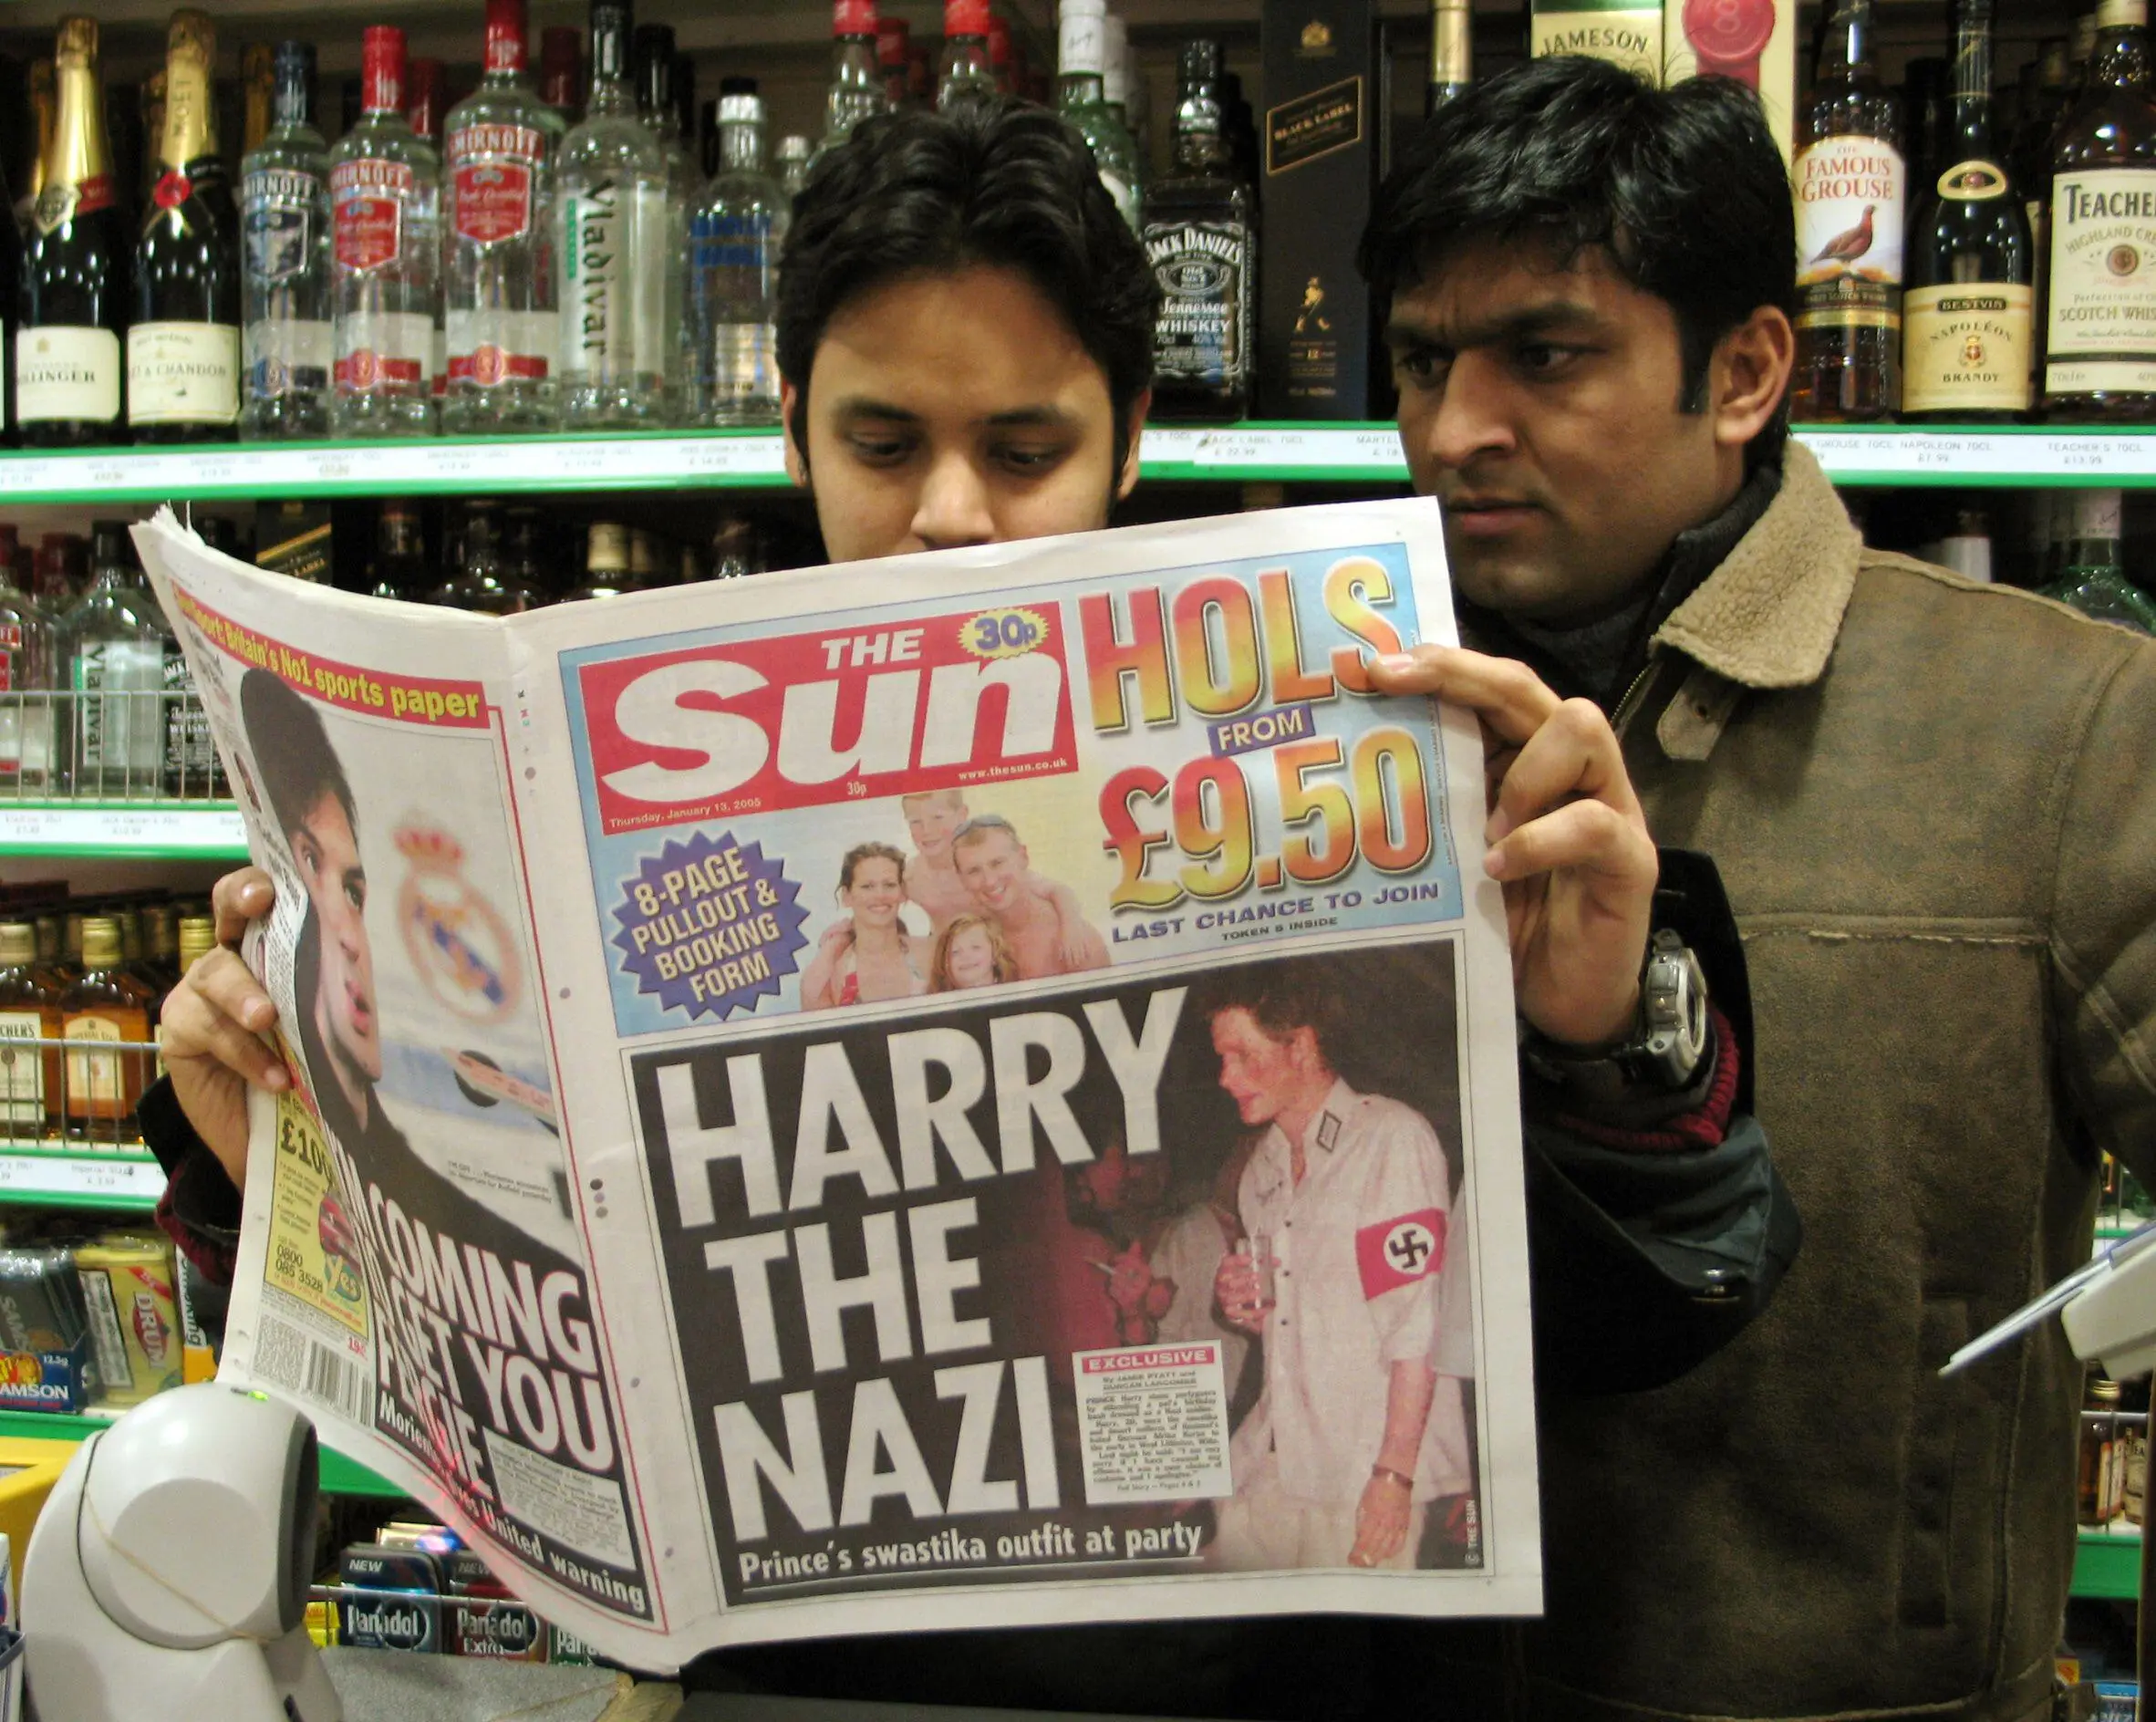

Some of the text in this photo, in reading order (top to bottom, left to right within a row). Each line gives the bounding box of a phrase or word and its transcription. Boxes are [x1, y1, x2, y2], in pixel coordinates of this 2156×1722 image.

[1540, 27, 1649, 56] JAMESON
[1804, 156, 1892, 180] FAMOUS
[1802, 180, 1893, 202] GROUSE
[2063, 183, 2156, 224] TEACHE
[1145, 234, 1184, 265] JACK
[2065, 225, 2133, 255] HIGHLAND
[583, 179, 616, 356] Vladivar
[1156, 319, 1231, 333] WHISKEY
[2059, 306, 2118, 322] SCOTCH
[1942, 371, 2000, 383] BRANDY
[1900, 441, 1961, 451] NAPOLEON
[821, 628, 928, 671] THE
[974, 614, 1038, 651] 30p
[1078, 555, 1405, 734] HOLS
[280, 649, 313, 688] No1
[314, 668, 385, 707] sports
[390, 685, 480, 721] paper
[600, 652, 1062, 804] Sun
[1218, 708, 1305, 752] FROM
[846, 781, 868, 797] 30p
[958, 756, 1069, 783] www.thesun.co.uk
[609, 812, 664, 829] Thursday,
[666, 804, 711, 821] January
[1097, 727, 1432, 916] £9.50
[633, 845, 750, 918] 8-PAGE
[630, 877, 780, 955] PULLOUT &
[1112, 883, 1439, 944] LAST CHANCE TO JOIN
[1222, 927, 1270, 942] TOKEN
[1289, 916, 1339, 930] INSIDE
[654, 912, 781, 981] BOOKING
[689, 949, 772, 1003] FORM
[655, 986, 1189, 1229] HARRY
[368, 1181, 599, 1376] COMING
[704, 1196, 993, 1385] THE
[136, 1292, 166, 1368] DRUM
[1089, 1349, 1208, 1371] EXCLUSIVE
[0, 1384, 69, 1400] AMSON
[462, 1333, 615, 1472] YOU
[713, 1355, 1061, 1543] NAZI
[348, 1559, 383, 1573] NEW
[482, 1502, 544, 1563] United
[550, 1551, 646, 1613] warning
[739, 1520, 1204, 1583] Prince's swastika outfit at party
[347, 1604, 419, 1636] Panadol
[457, 1607, 528, 1638] Panadol
